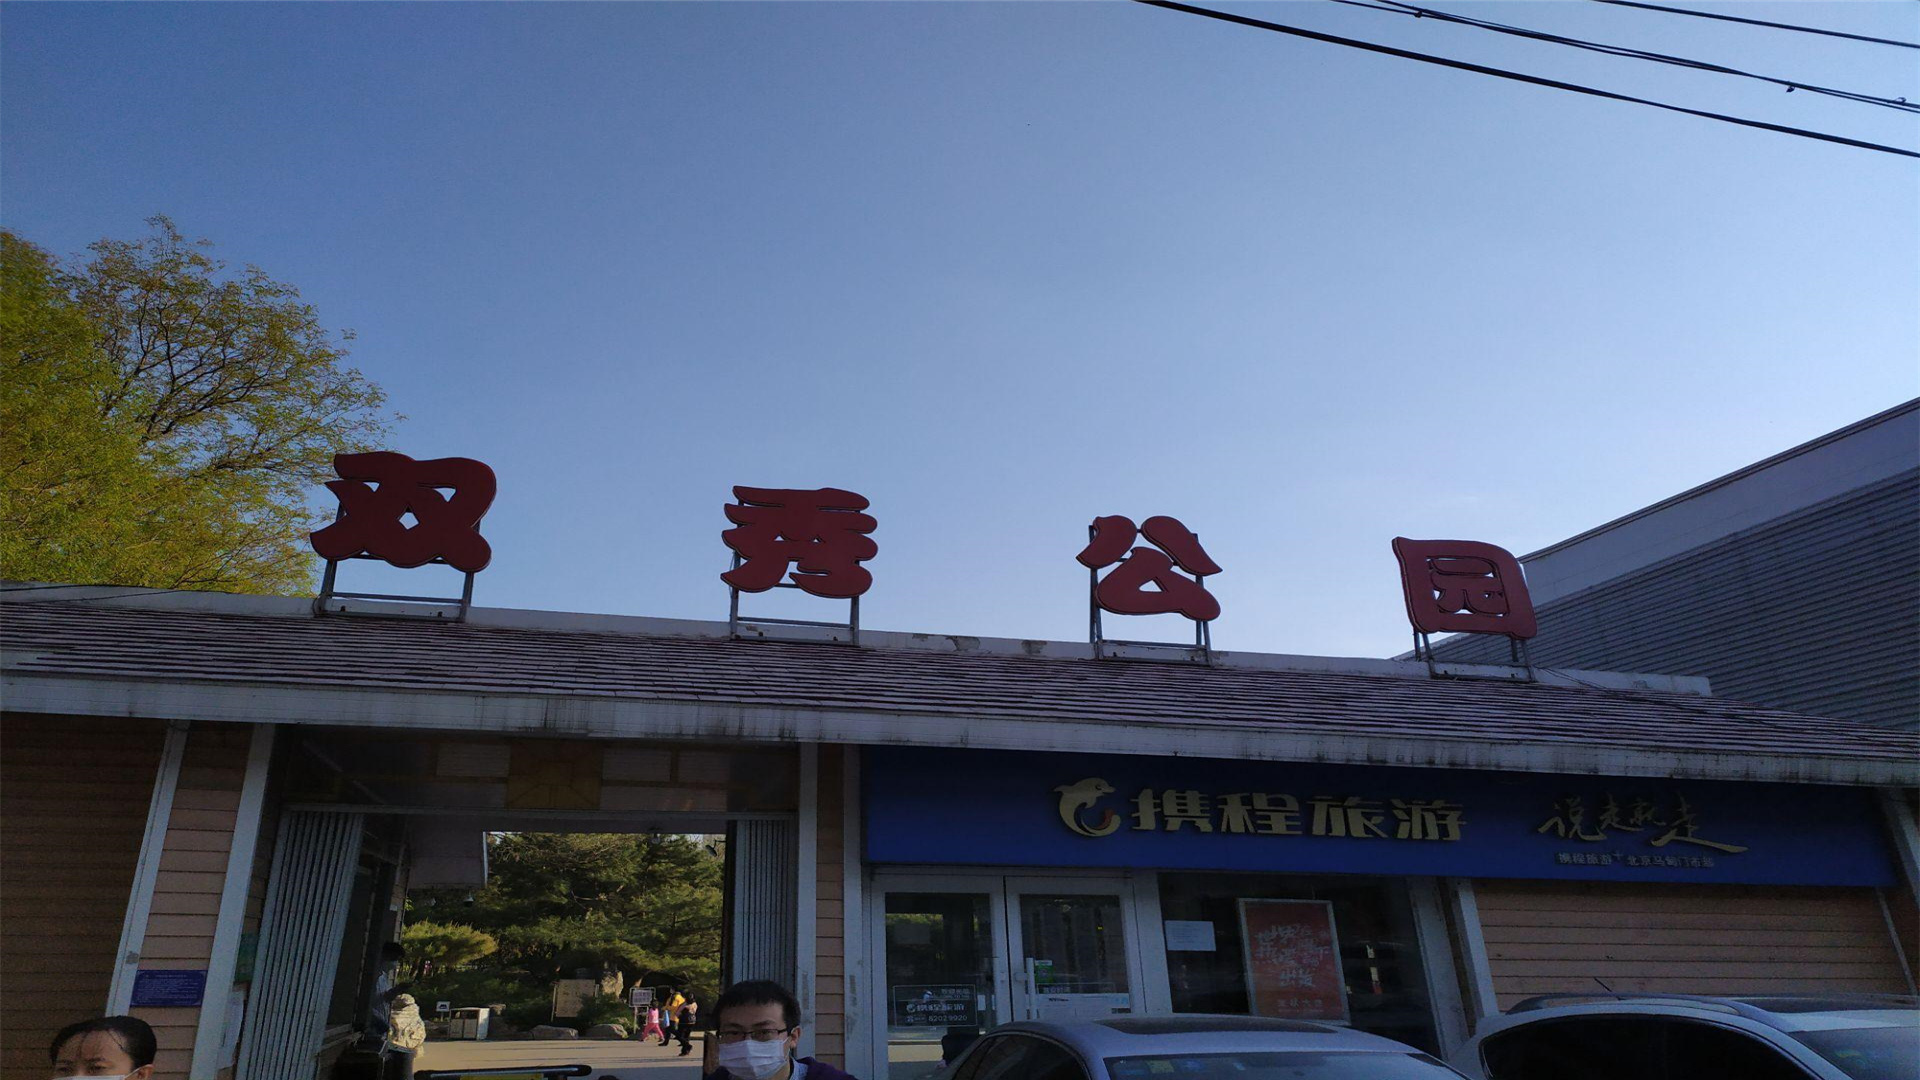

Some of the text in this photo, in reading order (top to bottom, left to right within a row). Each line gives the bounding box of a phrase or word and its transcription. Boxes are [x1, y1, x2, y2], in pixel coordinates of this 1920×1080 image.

[310, 452, 1536, 640] 双秀公园
[1130, 788, 1467, 841] 携程旅游
